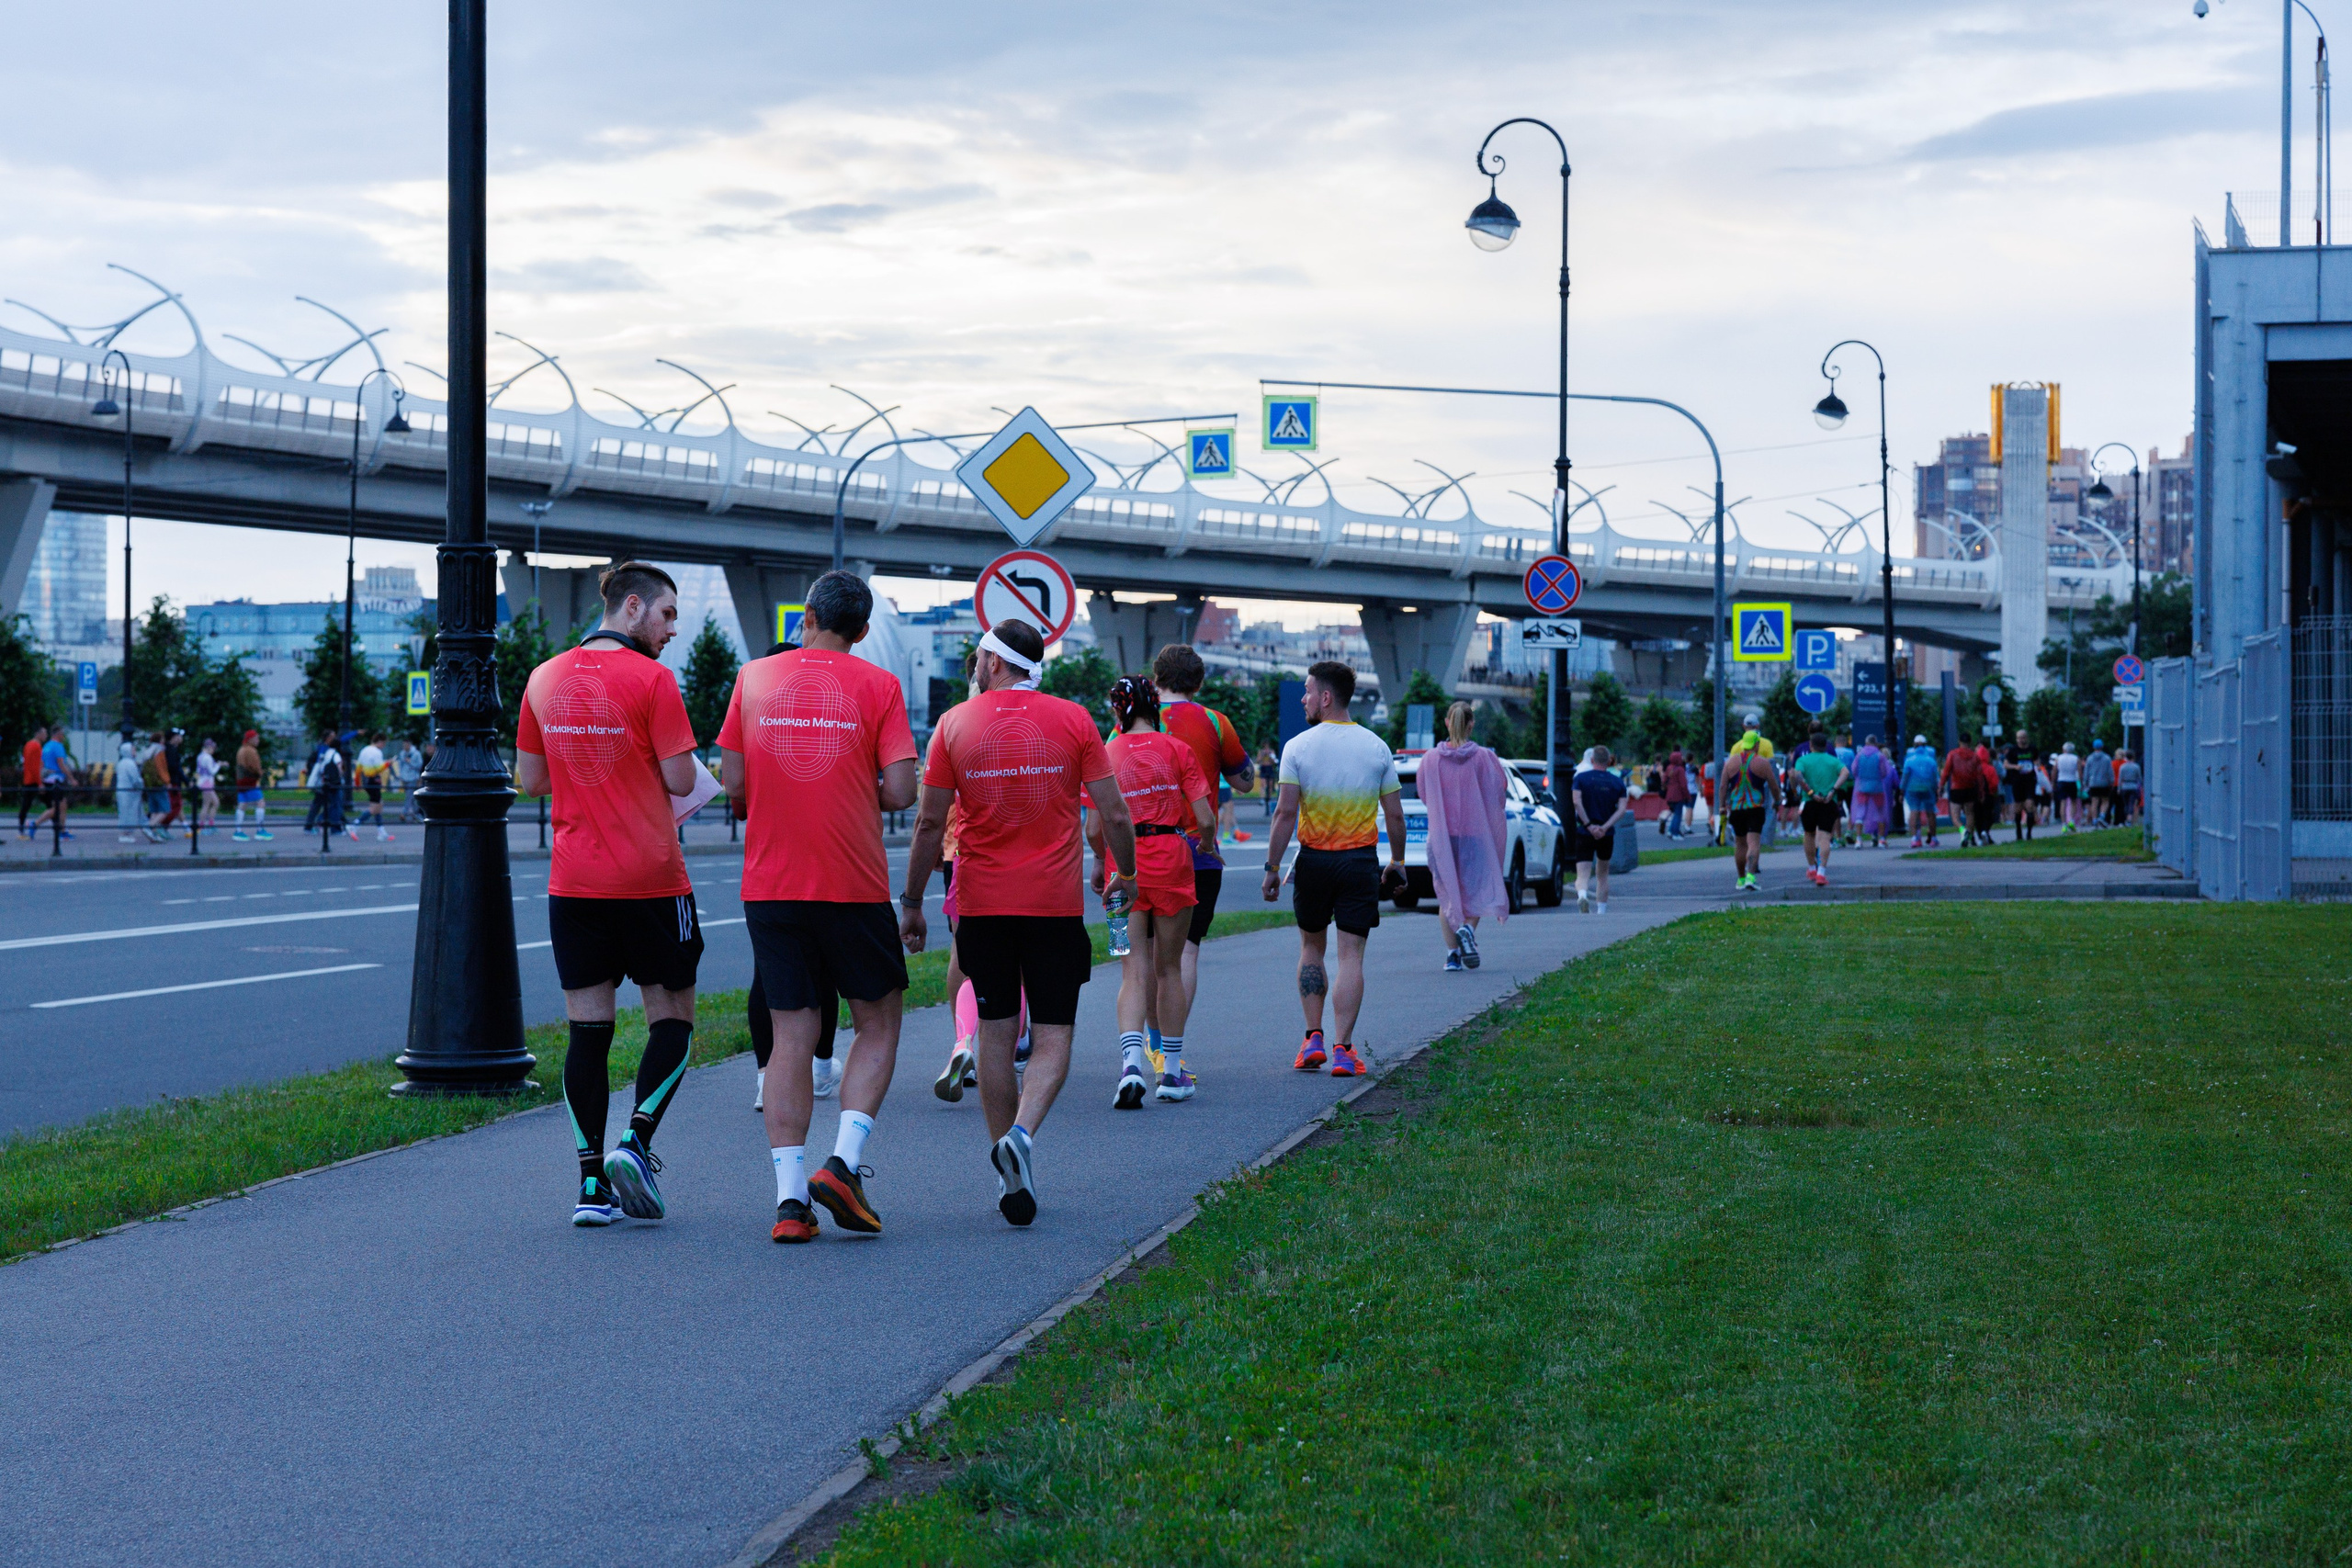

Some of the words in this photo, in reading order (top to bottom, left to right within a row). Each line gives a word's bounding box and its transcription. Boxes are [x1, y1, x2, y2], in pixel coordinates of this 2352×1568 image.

[1807, 635, 1828, 666] P
[588, 724, 625, 735] Магнит
[759, 716, 810, 728] Команда
[812, 717, 857, 731] Магнит
[966, 767, 1017, 780] Команда
[1020, 765, 1064, 775] Магнит
